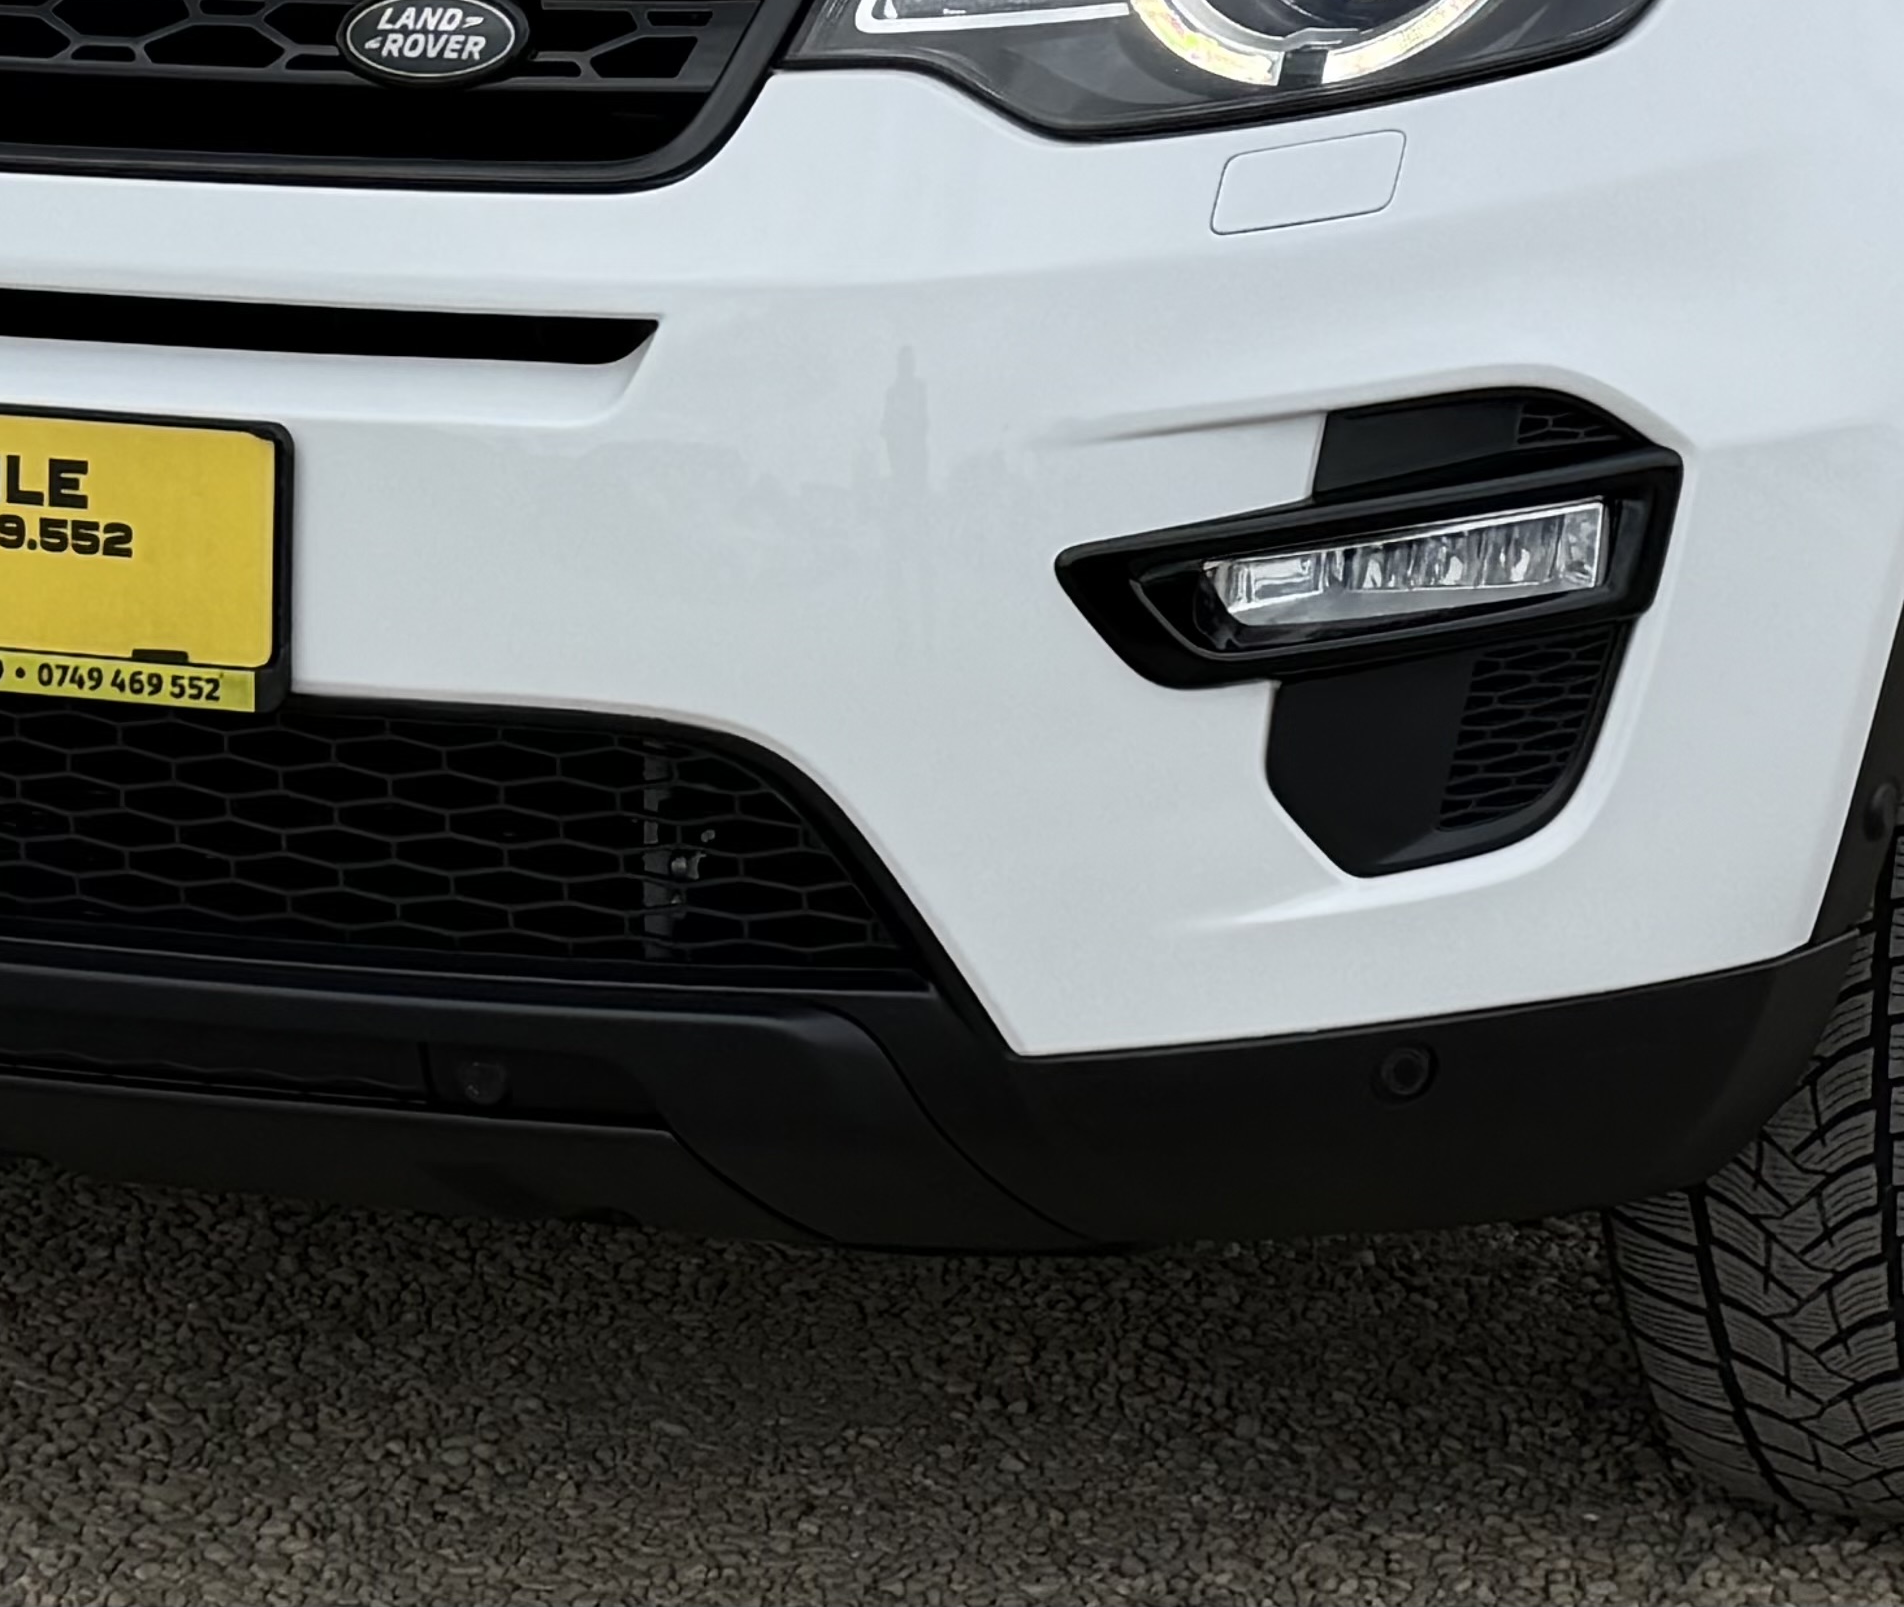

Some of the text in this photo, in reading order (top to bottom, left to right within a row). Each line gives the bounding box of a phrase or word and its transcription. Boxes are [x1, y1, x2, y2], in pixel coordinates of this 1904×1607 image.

[377, 6, 464, 32] LAND
[380, 32, 487, 61] ROVER
[37, 662, 104, 692] 0749
[110, 667, 164, 697] 469
[169, 674, 222, 703] 552
